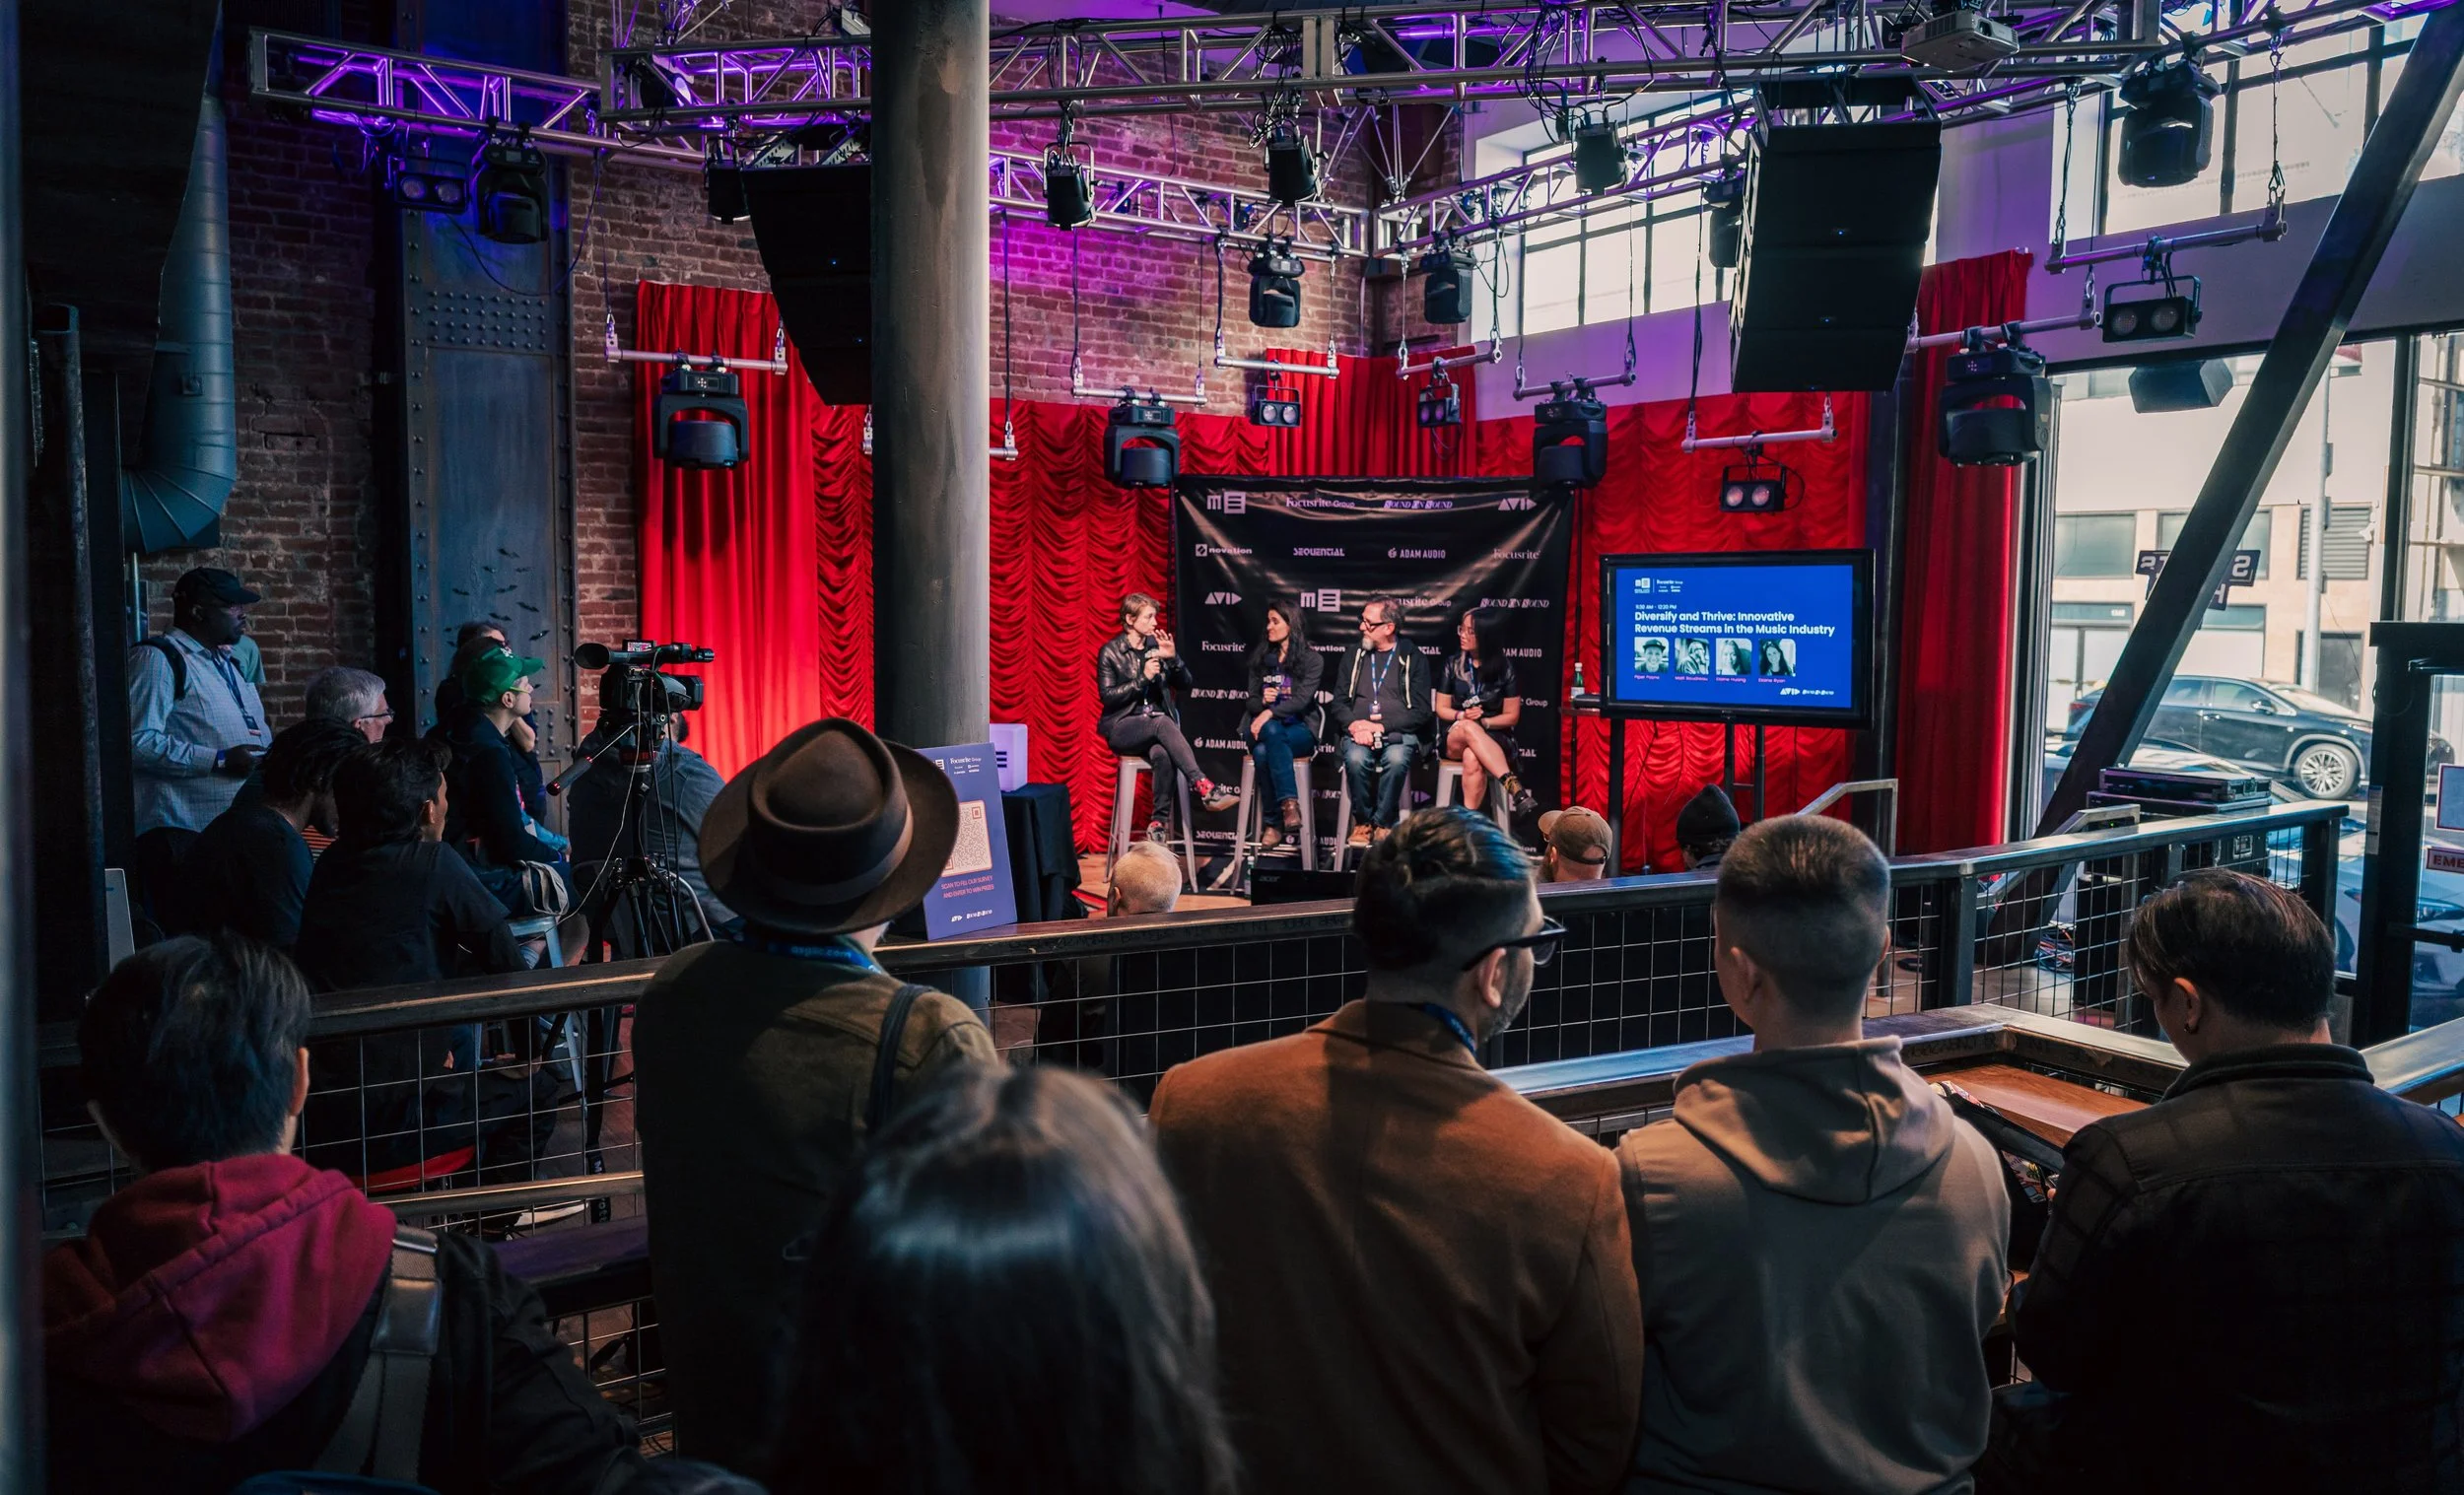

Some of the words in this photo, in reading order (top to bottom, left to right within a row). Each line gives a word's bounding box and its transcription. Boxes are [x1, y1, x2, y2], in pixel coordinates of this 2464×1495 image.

[1286, 497, 1331, 509] Focusrite
[1498, 498, 1538, 510] AVID
[1293, 547, 1345, 557] SEQUENTIAL
[1400, 549, 1421, 559] ADAM
[1422, 549, 1446, 559] AUDIO
[1493, 548, 1540, 560] Focusrite
[1204, 591, 1242, 605] AVID
[1635, 611, 1677, 624] Diversify
[1678, 611, 1699, 621] and
[1700, 611, 1736, 621] Thrive:
[1738, 611, 1795, 622] Innovative
[1635, 624, 1677, 633] Revenue
[1678, 624, 1723, 634] Streams
[1724, 624, 1734, 633] in
[1736, 624, 1753, 634] the
[1755, 624, 1787, 634] Music
[1789, 624, 1835, 638] Industry
[1201, 641, 1245, 652] Focusrite
[1519, 648, 1542, 657] AUDIO
[1525, 698, 1548, 708] Group
[1205, 739, 1226, 749] ADAM
